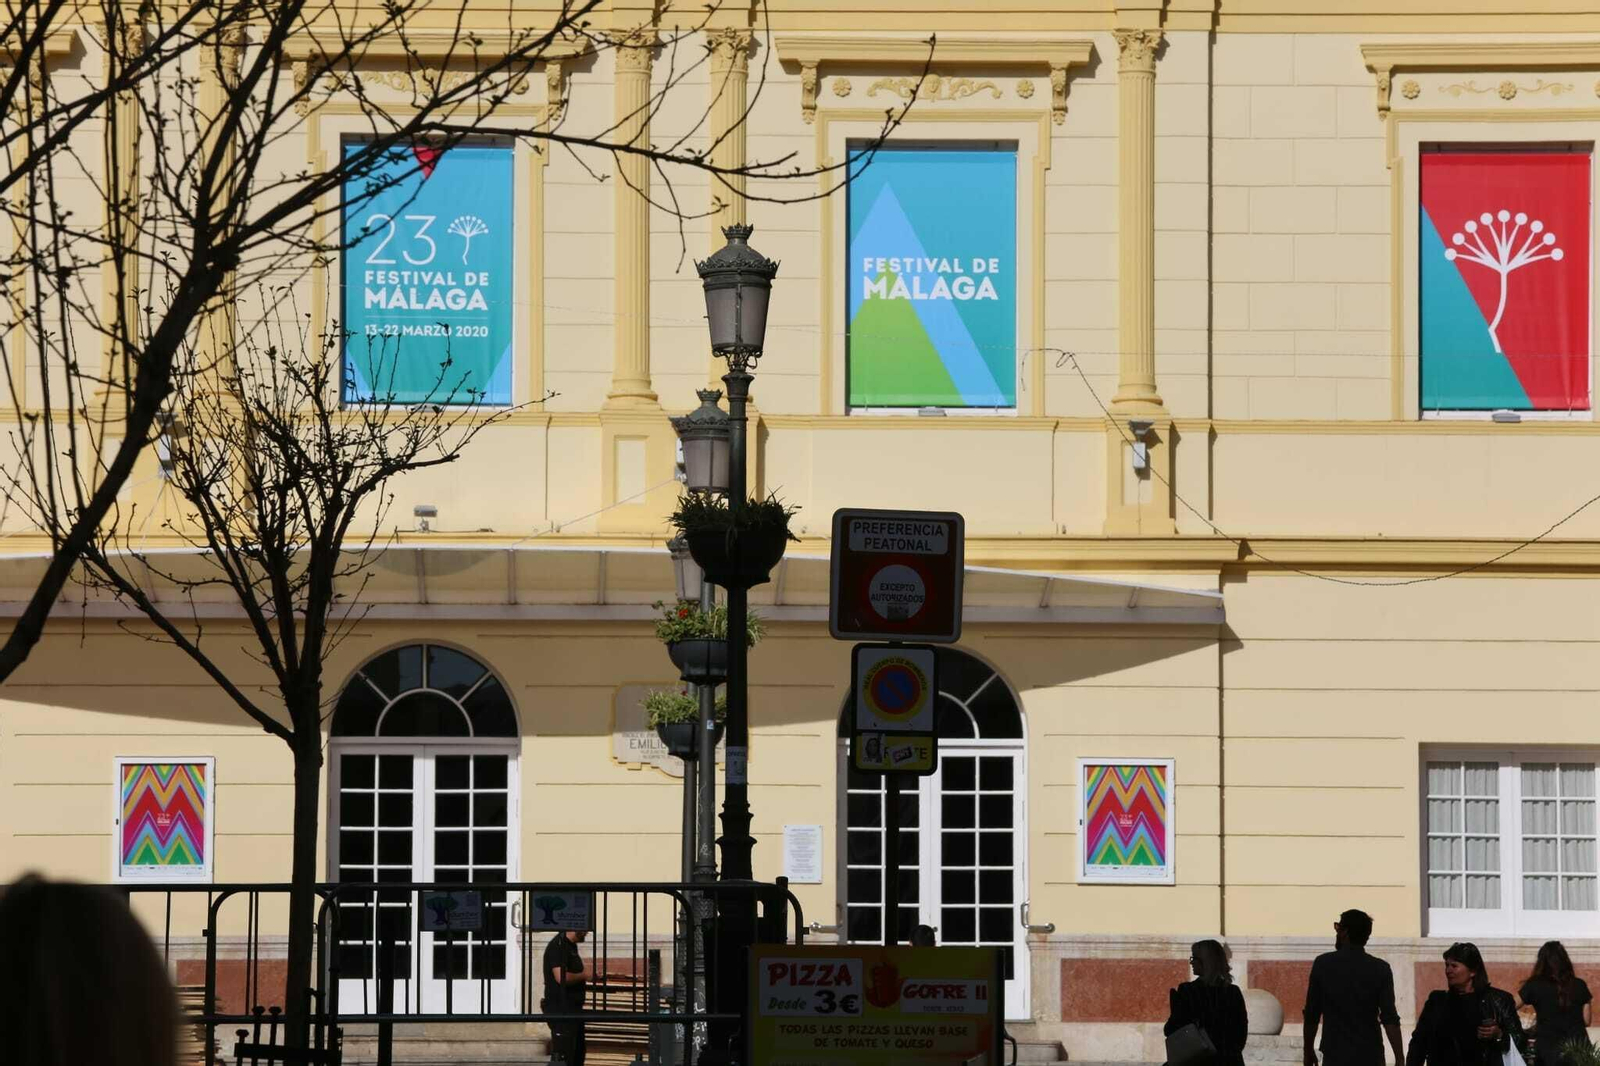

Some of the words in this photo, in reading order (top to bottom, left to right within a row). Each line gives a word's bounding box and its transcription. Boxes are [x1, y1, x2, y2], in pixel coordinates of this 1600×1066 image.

[365, 213, 437, 265] 23
[863, 257, 964, 273] FESTIVAL
[973, 258, 1000, 273] DE
[364, 270, 457, 286] FESTIVAL
[464, 272, 489, 286] DE
[863, 272, 998, 300] MÁLAGA
[364, 285, 488, 311] MÁLAGA
[364, 324, 399, 337] 13-22
[402, 325, 453, 338] MARZO
[455, 326, 489, 338] 2020
[853, 522, 944, 537] PREFERENCIA
[864, 538, 932, 551] PEATONAL
[879, 582, 916, 592] EXCEPTO
[767, 962, 852, 987] PIZZA
[903, 984, 967, 1000] GOFRE
[768, 997, 807, 1010] Desde
[814, 989, 859, 1014] 3€
[780, 1024, 818, 1034] TODAS
[822, 1024, 843, 1035] LAS
[894, 1026, 935, 1035] LLEVAN
[939, 1026, 968, 1036] BASE
[814, 1038, 830, 1048] DE
[834, 1038, 880, 1048] TOMATE
[883, 1039, 891, 1047] Y
[895, 1039, 934, 1049] QUESO
